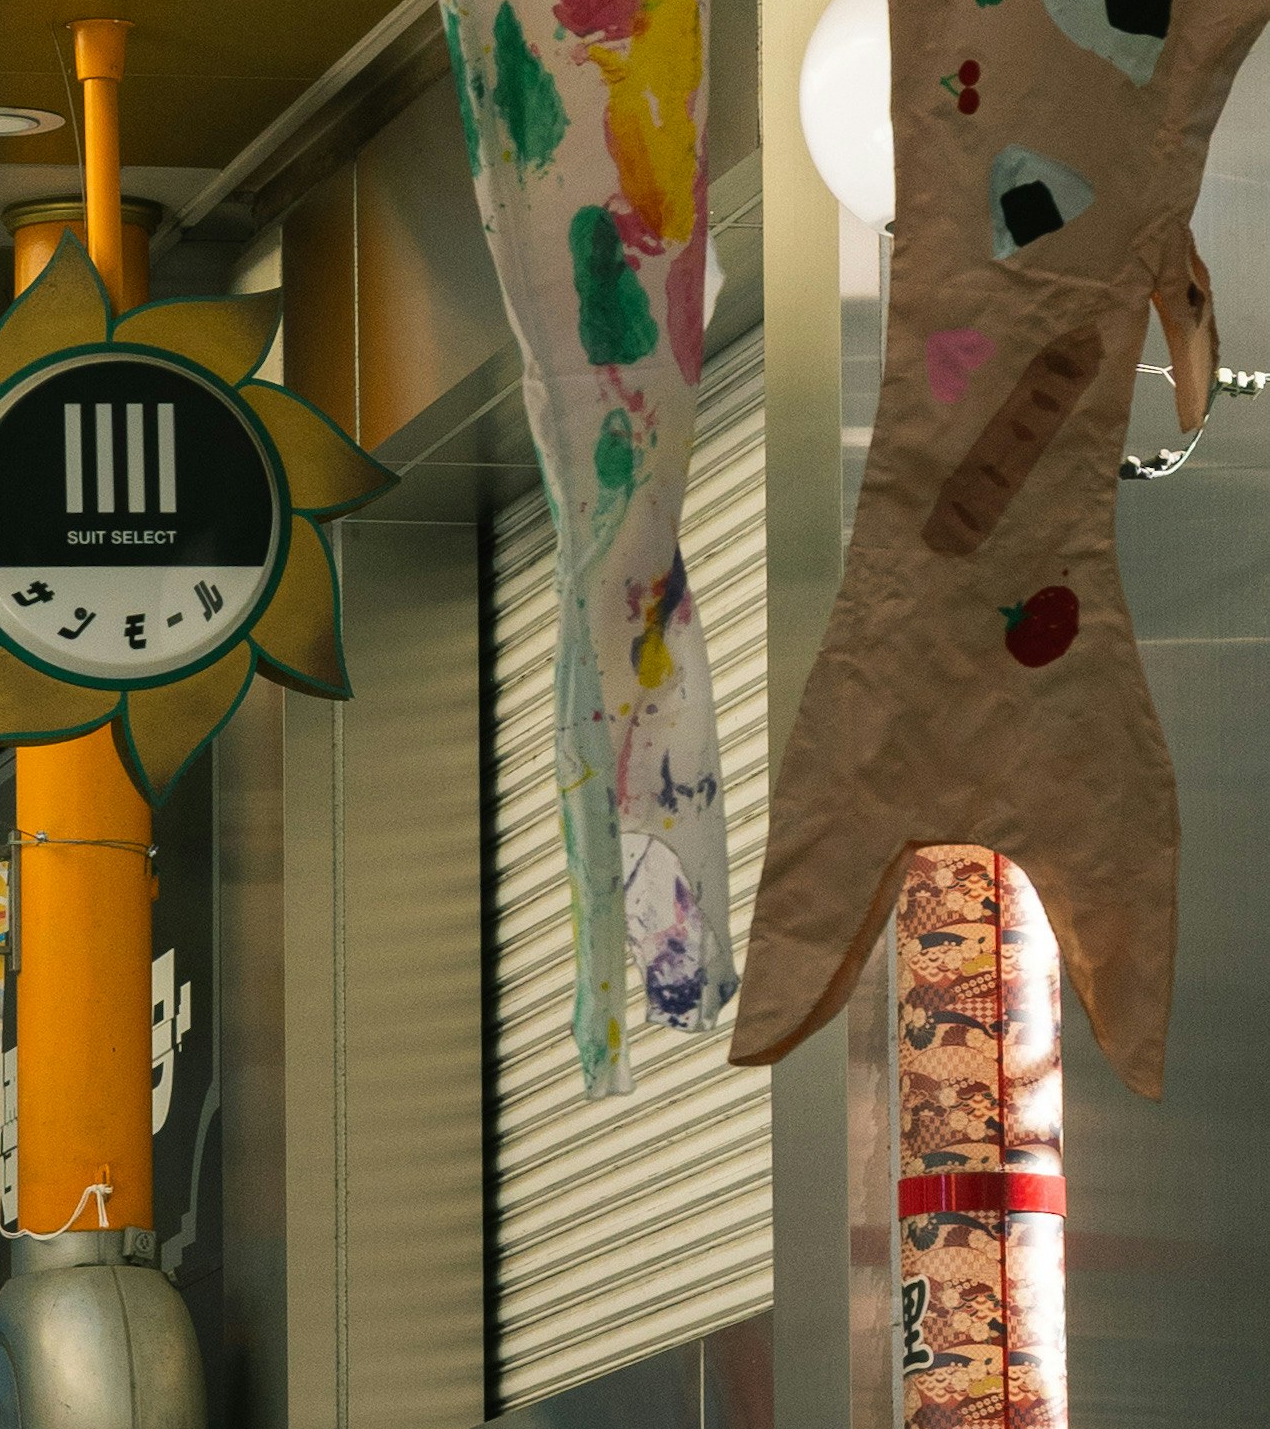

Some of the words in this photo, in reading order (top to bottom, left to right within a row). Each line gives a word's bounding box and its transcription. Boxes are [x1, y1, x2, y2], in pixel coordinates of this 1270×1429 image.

[67, 530, 107, 545] SUIT
[111, 530, 177, 545] SELECT
[14, 580, 224, 650] サンモール
